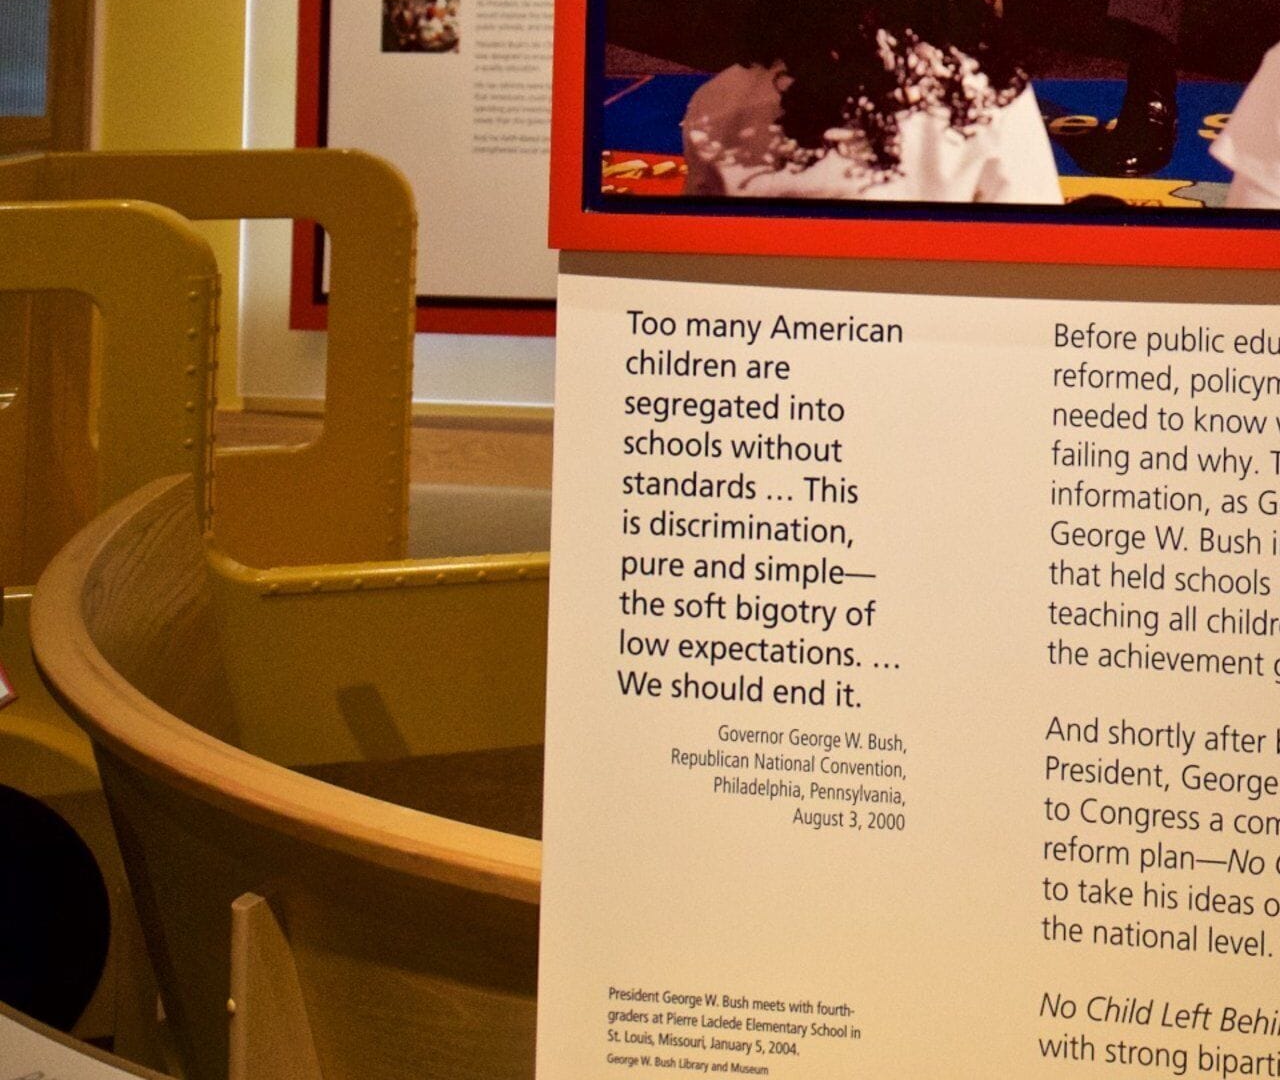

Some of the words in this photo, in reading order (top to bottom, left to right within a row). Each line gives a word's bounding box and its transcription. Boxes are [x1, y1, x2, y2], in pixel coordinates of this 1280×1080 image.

[626, 310, 676, 336] Too
[687, 318, 762, 345] many
[770, 315, 903, 343] American
[1054, 321, 1138, 351] Before
[1146, 325, 1225, 358] public
[626, 349, 736, 378] children
[746, 360, 790, 380] are
[1053, 360, 1180, 396] reformed,
[625, 393, 779, 424] segregated
[790, 394, 845, 422] into
[1052, 401, 1148, 431] needed
[1156, 406, 1185, 432] to
[1193, 404, 1268, 435] know
[624, 429, 722, 458] schools
[730, 433, 842, 463] without
[1050, 438, 1130, 477] failing
[1139, 444, 1188, 472] and
[1196, 446, 1260, 482] why.
[623, 471, 756, 500] standards
[803, 476, 858, 504] This
[1051, 479, 1211, 517] information,
[1220, 493, 1249, 515] as
[623, 509, 640, 535] is
[650, 510, 853, 549] discrimination,
[622, 556, 684, 581] pure
[693, 553, 745, 580] and
[619, 589, 665, 616] the
[674, 592, 726, 619] soft
[736, 593, 837, 632] bigotry
[846, 600, 876, 626] of
[620, 628, 670, 657] low
[678, 638, 861, 667] expectations.
[617, 670, 662, 697] We
[671, 672, 763, 702] should
[773, 679, 825, 706] end
[837, 681, 861, 708] it.
[718, 725, 784, 745] Governor
[789, 729, 841, 752] George
[845, 731, 863, 749] W.
[868, 733, 907, 754] Bush,
[672, 748, 749, 770] Republican
[754, 752, 816, 773] National
[820, 756, 906, 781] Convention,
[714, 776, 805, 801] Philadelphia,
[810, 782, 906, 807] Pennsylvania,
[793, 807, 844, 830] August
[849, 810, 862, 831] 3,
[867, 811, 905, 831] 2000
[1041, 913, 1084, 944] the
[1093, 920, 1198, 952] national
[1208, 925, 1273, 958] level.
[608, 986, 660, 1003] President
[662, 990, 703, 1009] George
[704, 993, 719, 1007] W.
[722, 994, 749, 1010] Bush
[752, 1000, 786, 1012] meets
[789, 1000, 814, 1014] with
[607, 1008, 649, 1025] graders
[651, 1012, 664, 1025] at
[666, 1011, 698, 1027] Pierre
[701, 1014, 743, 1031] Laclede
[745, 1017, 808, 1038] Elementary
[810, 1022, 847, 1038] School
[850, 1025, 861, 1039] in
[624, 1030, 655, 1047] Louis,
[658, 1032, 707, 1050] Missouri,
[710, 1036, 753, 1056] January
[755, 1039, 766, 1056] 5,
[768, 1040, 800, 1056] 2004.
